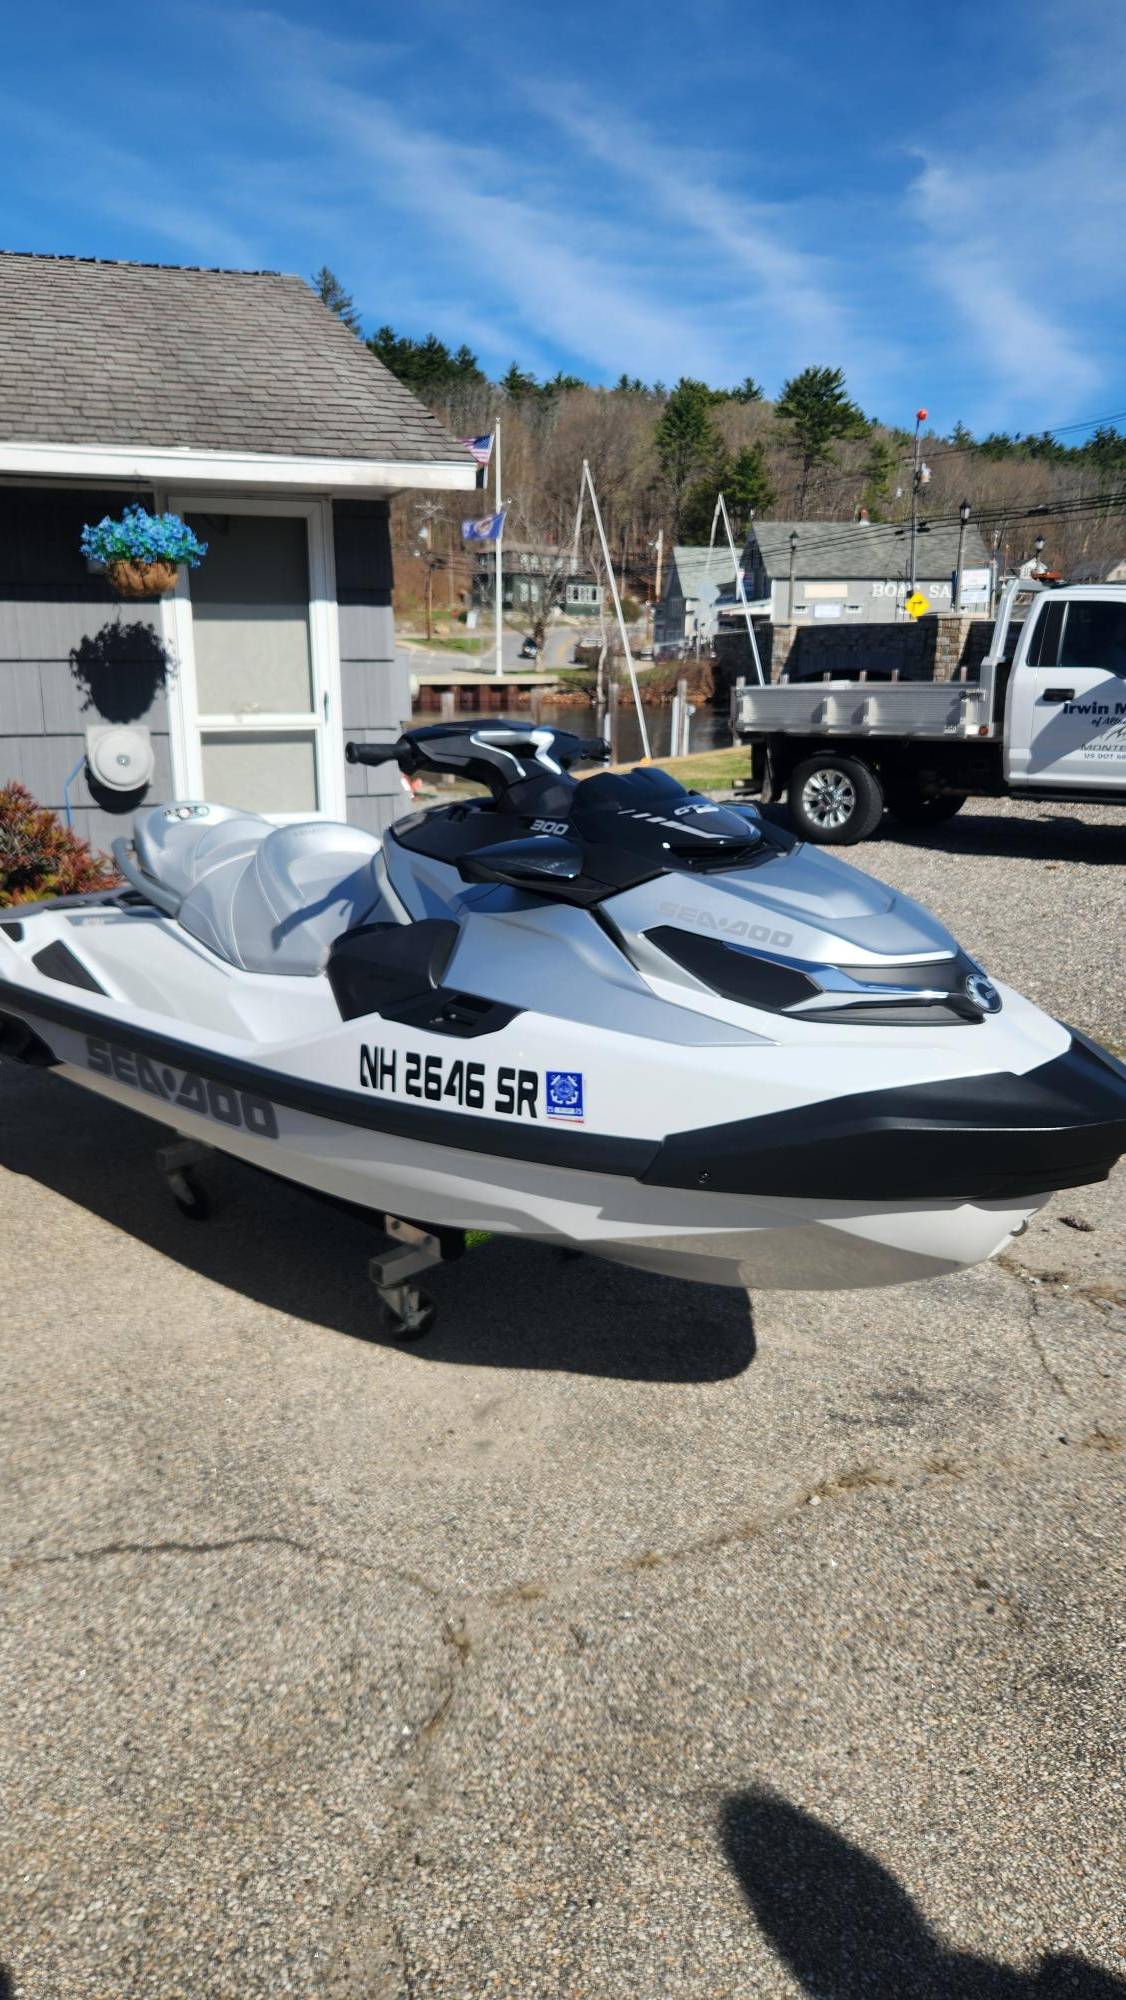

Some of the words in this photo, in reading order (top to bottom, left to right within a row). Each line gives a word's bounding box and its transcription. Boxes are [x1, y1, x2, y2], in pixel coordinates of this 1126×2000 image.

[1063, 701, 1109, 715] Irwin
[530, 819, 569, 835] 300
[359, 1043, 397, 1093] NH
[405, 1051, 486, 1110] 2646
[494, 1066, 539, 1119] SR
